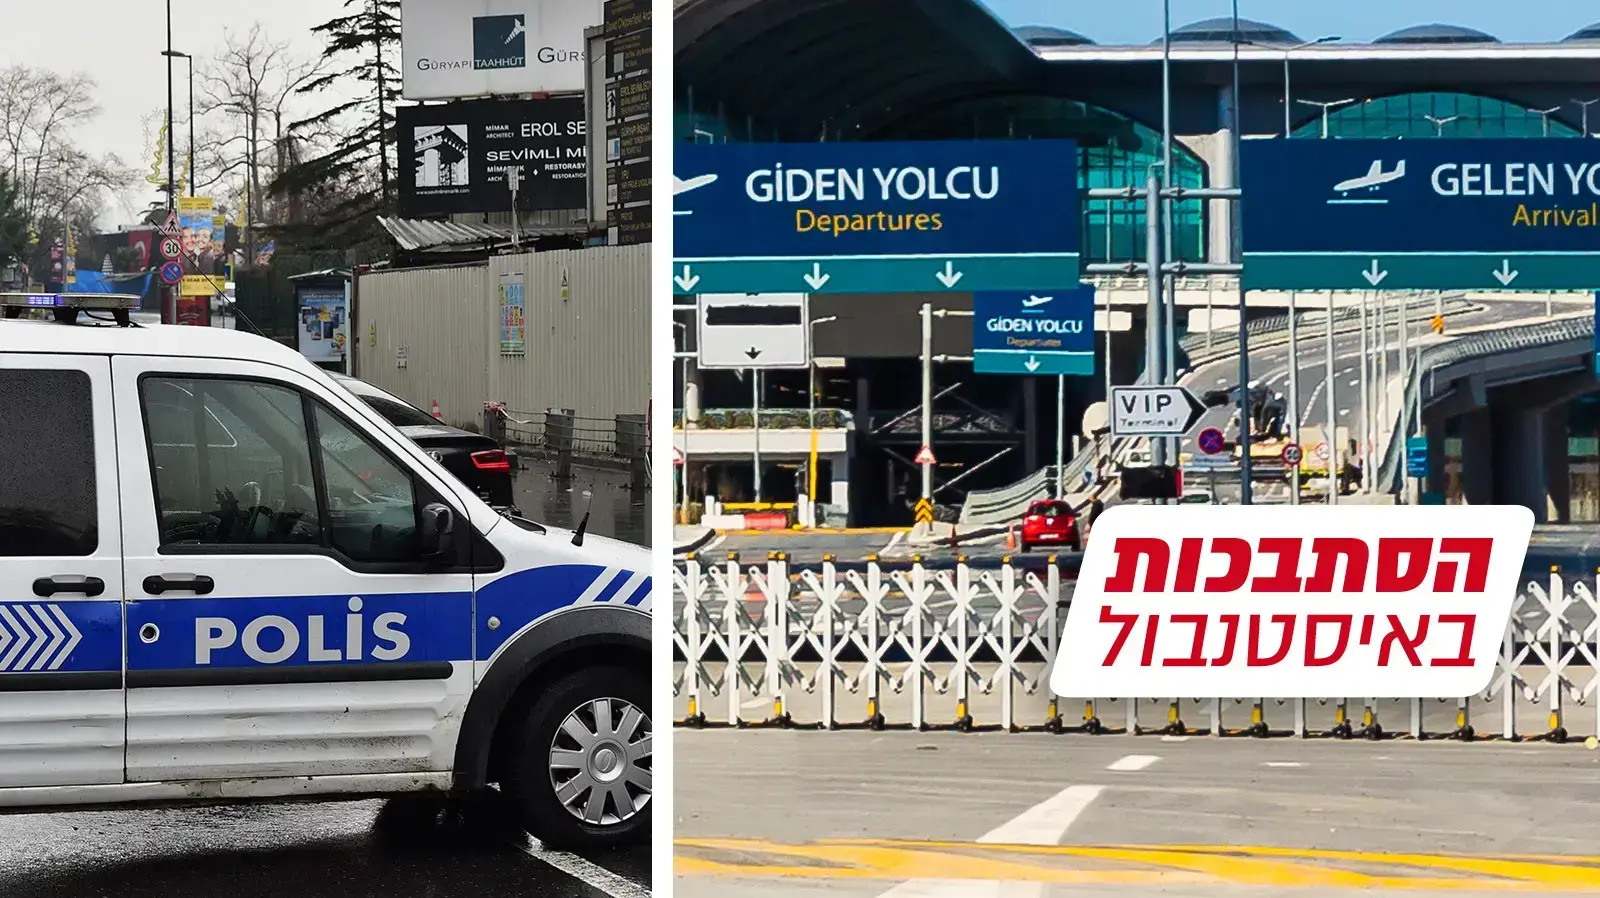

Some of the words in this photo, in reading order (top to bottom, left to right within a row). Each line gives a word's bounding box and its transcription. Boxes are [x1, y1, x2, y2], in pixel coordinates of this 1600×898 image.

[417, 58, 472, 71] GÜRYAPI
[474, 56, 525, 68] TAAHHÜT
[521, 122, 562, 137] EROL
[566, 120, 586, 136] SE
[486, 146, 560, 161] SEVİMLİ
[745, 162, 865, 203] GİDEN
[872, 166, 1000, 201] YOLCU
[1431, 162, 1554, 196] GELEN
[796, 209, 943, 238] Departures
[165, 242, 179, 254] 30
[986, 316, 1033, 332] GİDEN
[1034, 319, 1084, 334] YOLCU
[1121, 394, 1172, 414] VIP
[194, 596, 412, 665] POLİS
